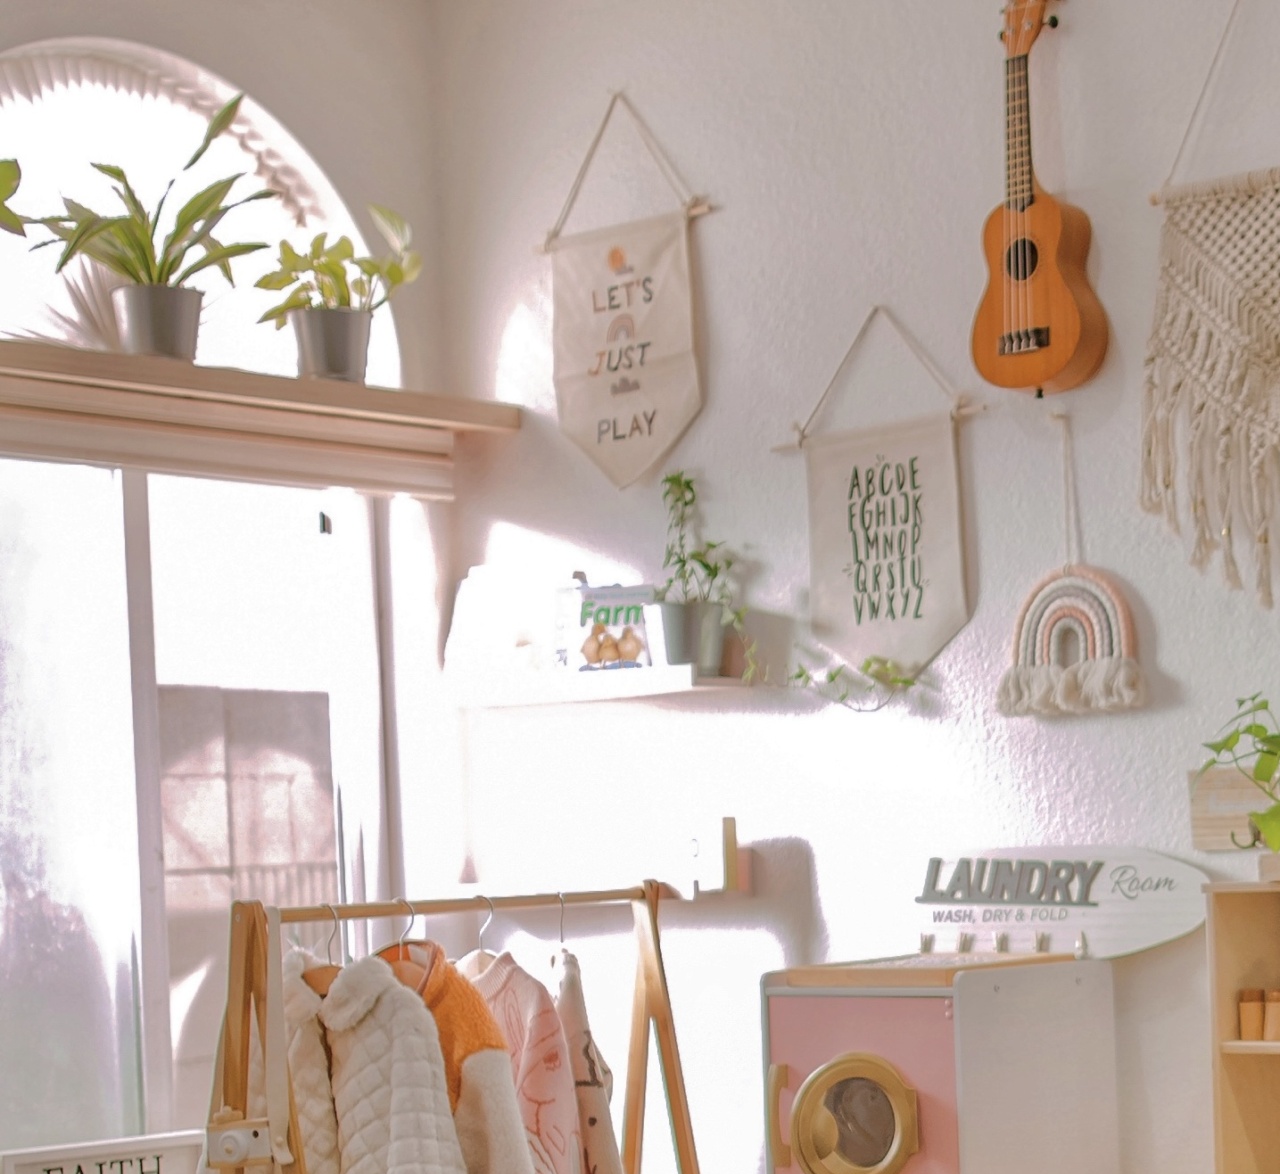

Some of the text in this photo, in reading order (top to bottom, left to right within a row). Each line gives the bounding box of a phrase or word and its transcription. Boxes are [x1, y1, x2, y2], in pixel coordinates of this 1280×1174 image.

[592, 276, 653, 314] LET'S
[588, 341, 651, 376] JUST
[597, 409, 657, 444] PLAY
[580, 600, 643, 627] Farm
[920, 857, 1178, 904] LAUNDRY Room
[932, 908, 1068, 924] WASH, DRY & FOLD
